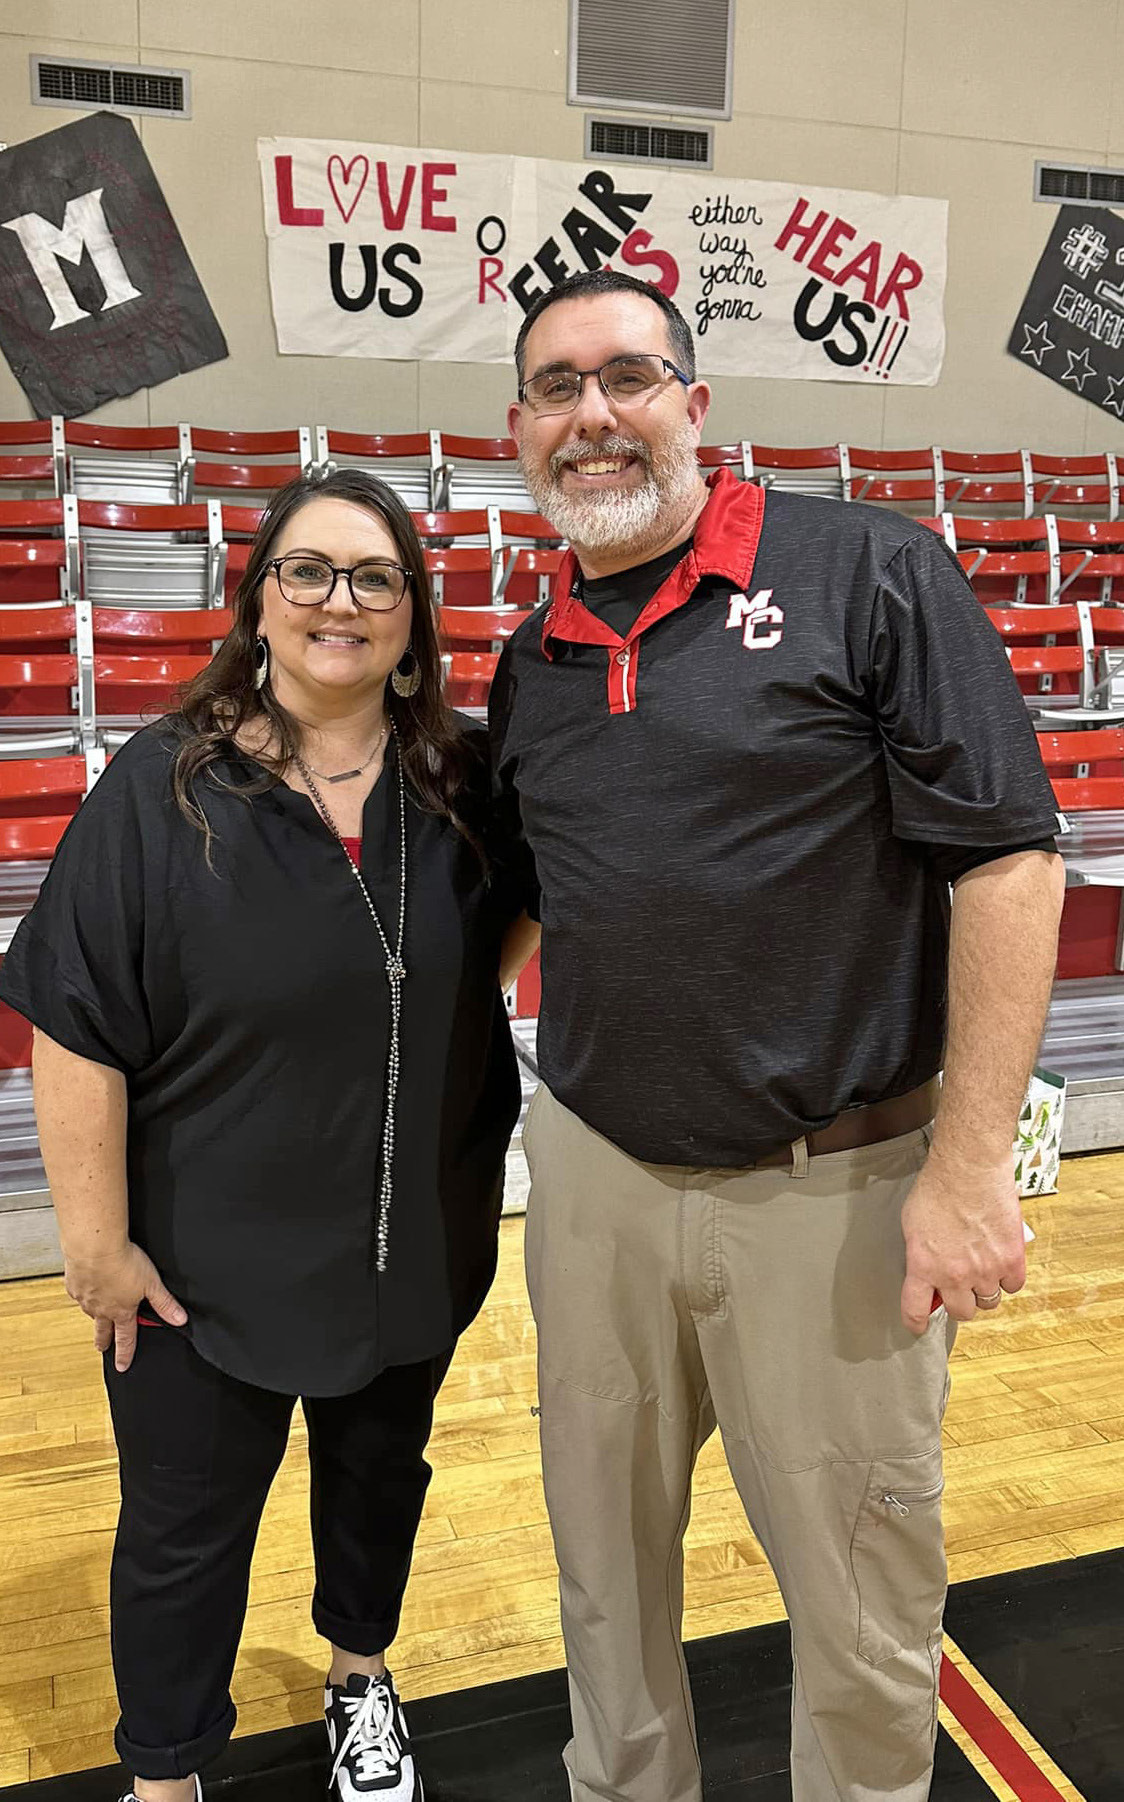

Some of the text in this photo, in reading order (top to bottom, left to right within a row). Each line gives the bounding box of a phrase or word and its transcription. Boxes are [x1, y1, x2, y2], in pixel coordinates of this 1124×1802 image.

[507, 170, 653, 316] FEAR
[688, 194, 763, 226] either
[1, 188, 142, 331] M
[329, 242, 423, 317] US
[602, 228, 680, 298] S
[699, 232, 754, 268] way
[700, 264, 767, 296] you're
[774, 197, 923, 322] HEAR
[695, 298, 762, 336] gonna
[794, 276, 909, 380] US!!!
[725, 588, 784, 650] MC
